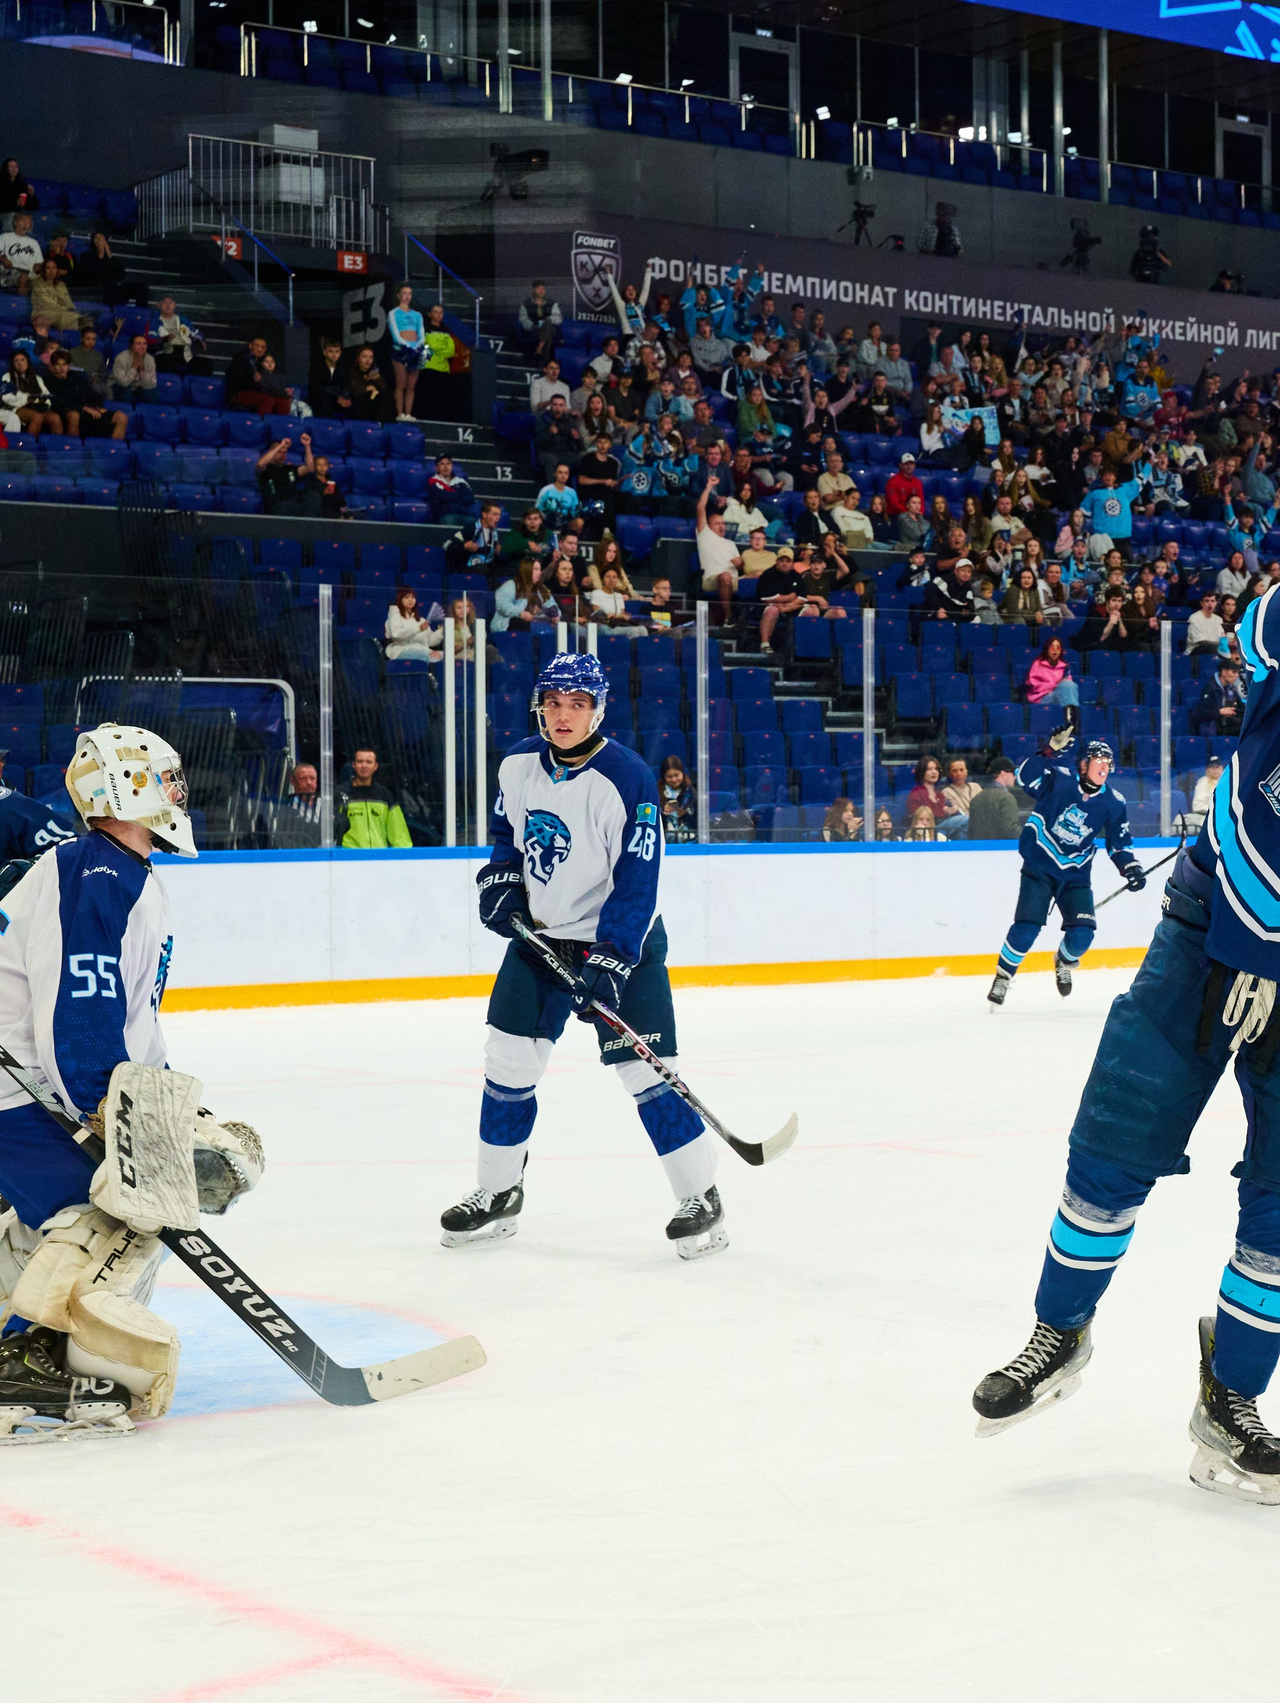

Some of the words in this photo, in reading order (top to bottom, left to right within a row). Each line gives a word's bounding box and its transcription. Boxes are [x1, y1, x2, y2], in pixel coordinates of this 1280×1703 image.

[577, 235, 616, 249] FONBET
[343, 255, 364, 270] E3
[343, 282, 387, 348] E3
[904, 288, 1115, 334] КОНТИНЕНТАЛЬНОЙ
[489, 339, 504, 353] 17
[457, 428, 474, 443] 14
[495, 466, 513, 481] 13
[581, 545, 594, 561] 11
[627, 826, 657, 861] 48
[68, 953, 118, 999] 55
[543, 953, 559, 969] ACE
[557, 966, 577, 987] prime
[603, 1033, 661, 1052] BAER
[622, 1031, 689, 1099] SOYUZ
[117, 1090, 137, 1190] CCM
[179, 1235, 296, 1338] SOYUZ
